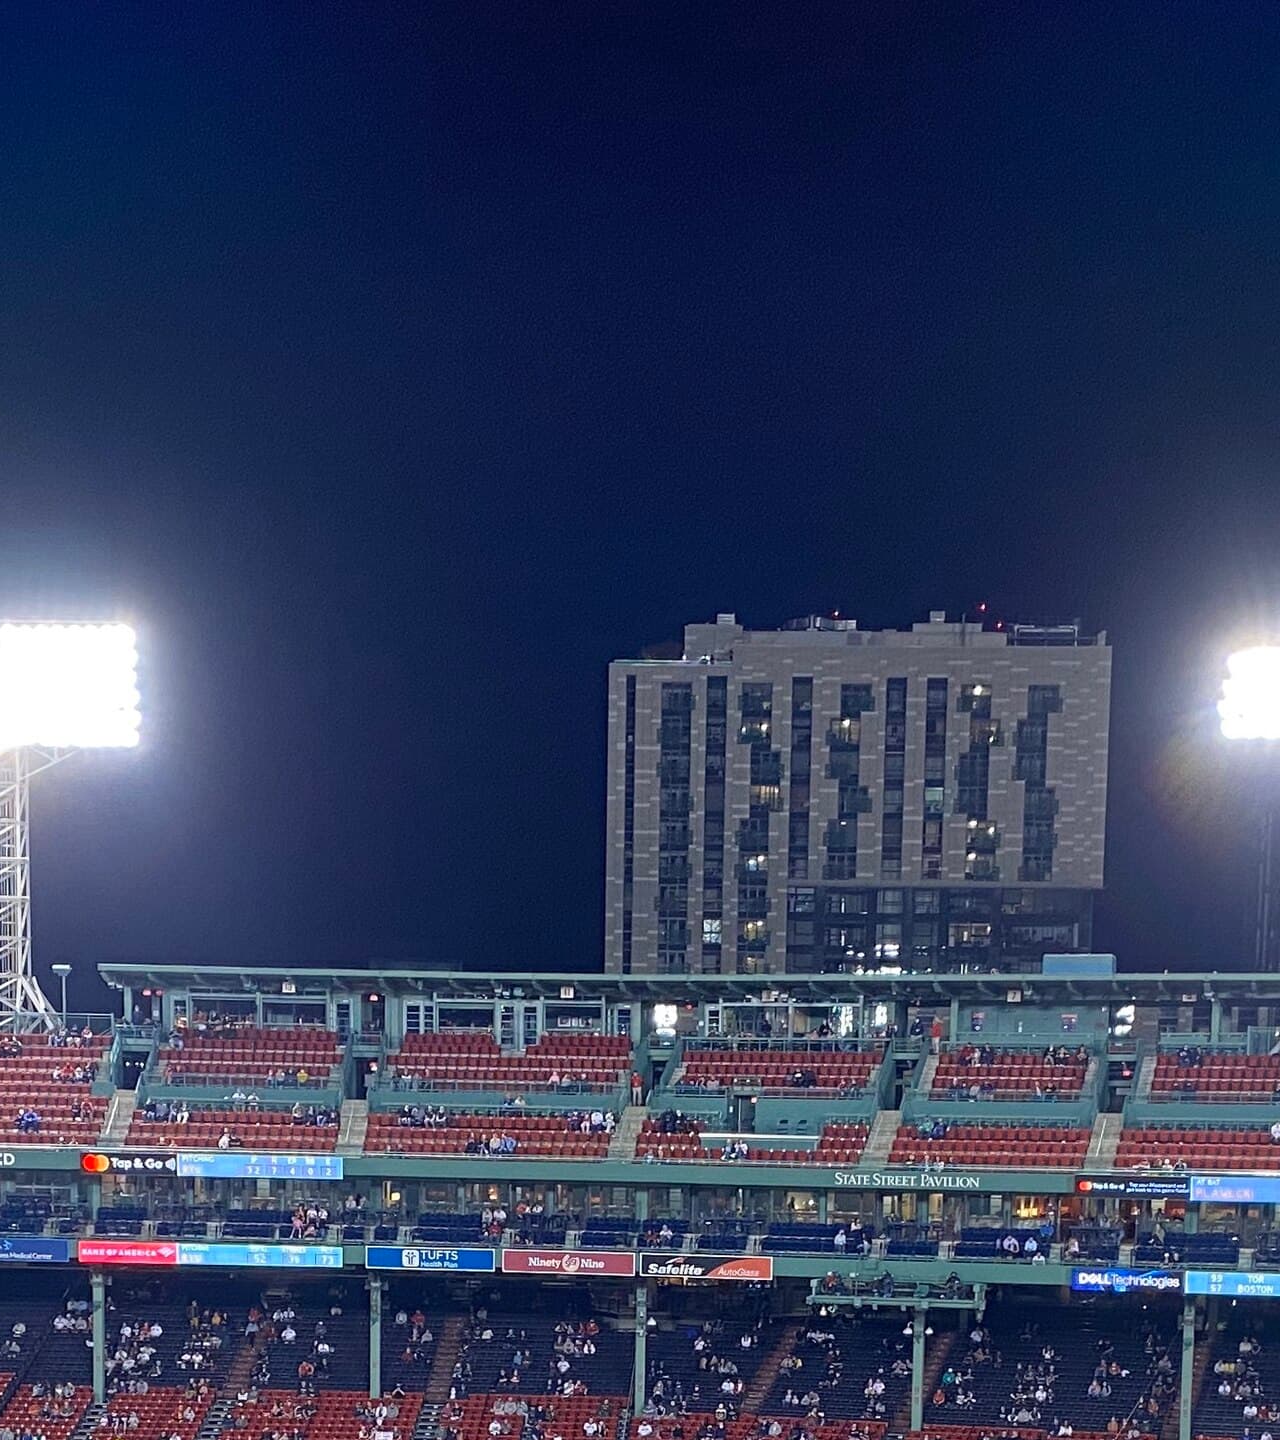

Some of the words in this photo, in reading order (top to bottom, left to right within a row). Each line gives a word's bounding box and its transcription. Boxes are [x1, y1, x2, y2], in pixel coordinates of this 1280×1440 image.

[110, 1157, 132, 1170] Tap
[133, 1157, 142, 1169] &
[144, 1158, 164, 1169] Go
[834, 1171, 870, 1185] STATE
[872, 1173, 917, 1187] STREET
[920, 1174, 980, 1188] PAVILION
[81, 1248, 105, 1256] BANK
[421, 1249, 458, 1260] TUFTS
[528, 1257, 561, 1269] Ninety
[580, 1259, 605, 1268] Nine
[647, 1263, 704, 1276] Safelite
[718, 1267, 760, 1277] AutoGlass
[1078, 1273, 1111, 1285] DELL
[1112, 1273, 1180, 1289] Technologies
[1247, 1273, 1265, 1284] TOR
[1237, 1284, 1273, 1294] BOSTON
